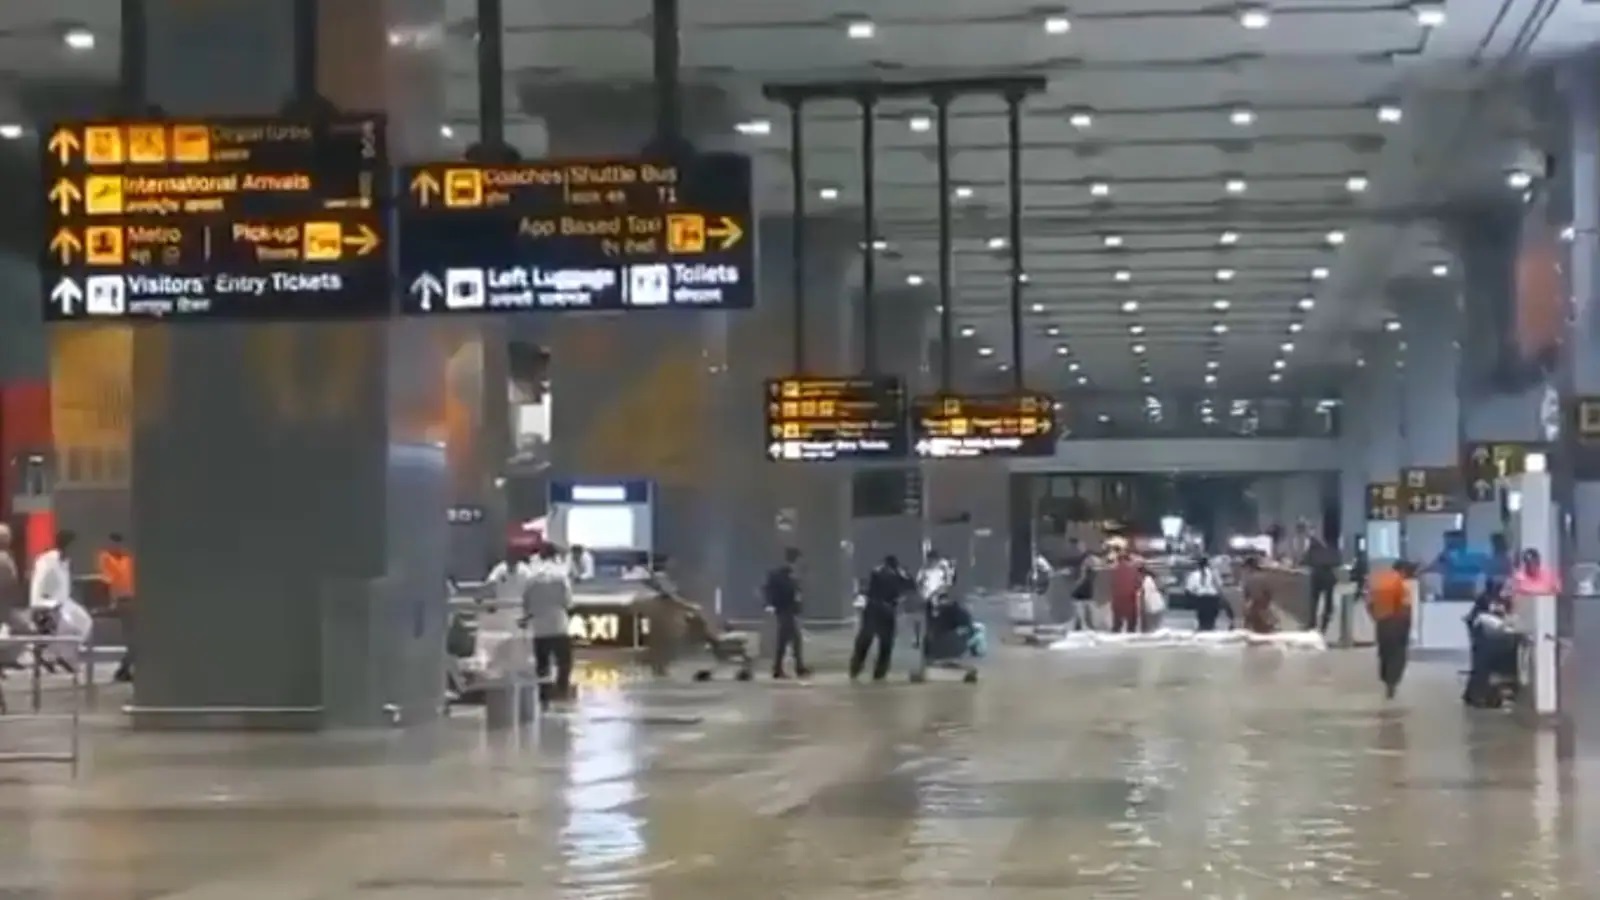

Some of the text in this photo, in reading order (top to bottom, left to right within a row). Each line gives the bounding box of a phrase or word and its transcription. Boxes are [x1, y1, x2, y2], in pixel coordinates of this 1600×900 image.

[124, 174, 237, 192] International
[242, 173, 311, 191] Arrivals
[484, 168, 562, 185] Coaches
[571, 164, 677, 182] Shuttle Bus
[128, 225, 182, 243] Metro
[518, 216, 661, 238] App Based Taxi
[215, 273, 267, 295] Entry
[272, 272, 342, 291] Tickets
[488, 266, 527, 287] Left
[672, 262, 738, 284] Toilets
[566, 613, 619, 639] AXI
